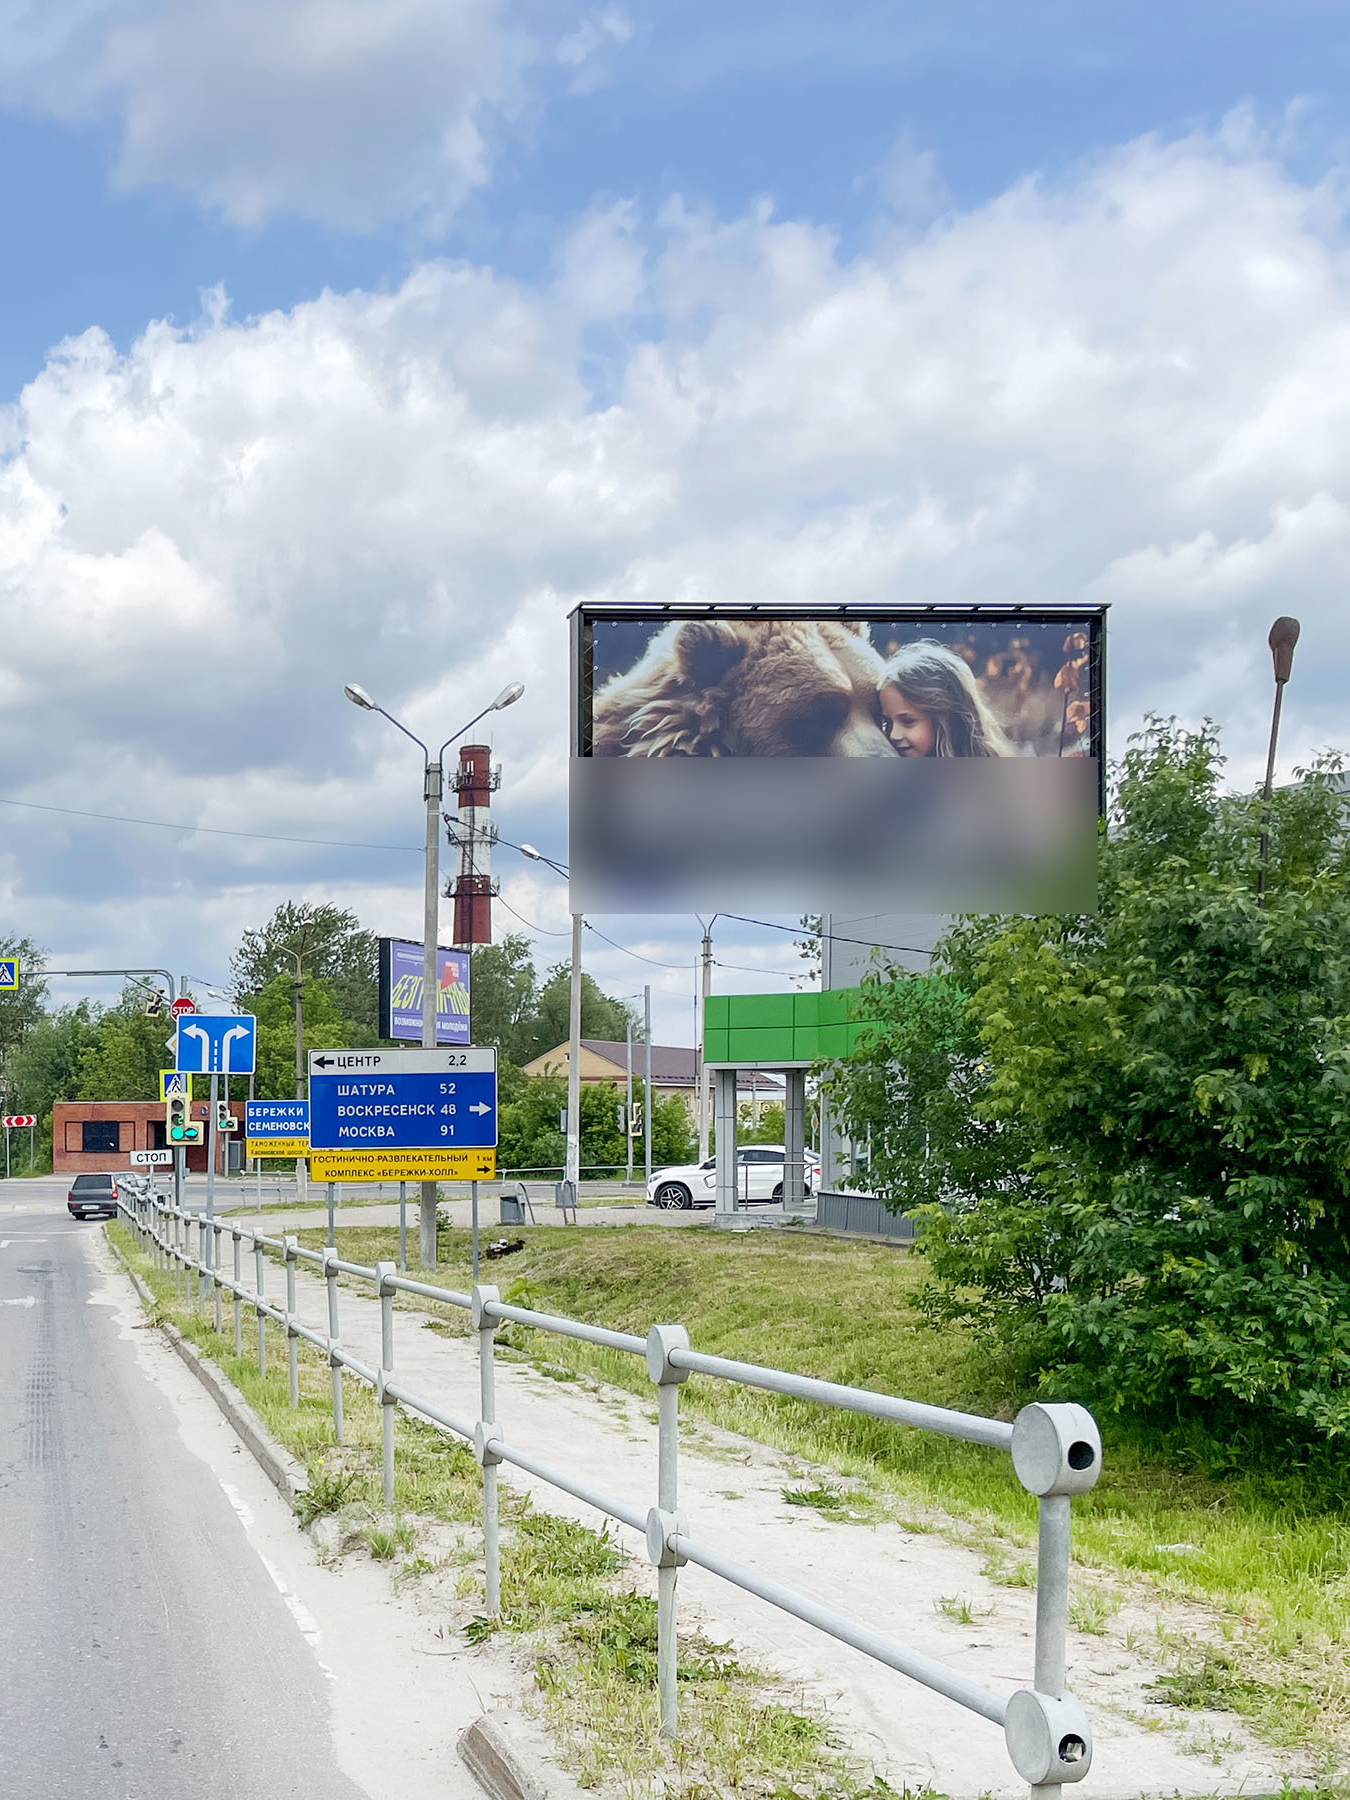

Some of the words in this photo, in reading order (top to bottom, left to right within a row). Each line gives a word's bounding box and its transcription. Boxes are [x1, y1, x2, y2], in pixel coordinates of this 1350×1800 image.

[172, 1006, 194, 1015] STOP
[337, 1056, 381, 1069] ЦЕНТР
[448, 1055, 467, 1067] 2,2
[337, 1084, 395, 1096] ШАТУРА
[439, 1083, 456, 1095] 52
[248, 1107, 304, 1117] БЕРЕЖКИ
[337, 1104, 435, 1117] ВОСКРЕСЕНСК
[440, 1103, 457, 1115] 48
[338, 1125, 395, 1138] МОСКВА
[440, 1124, 454, 1136] 91
[250, 1140, 295, 1148] ТАМОЖЕННЫЙ
[136, 1152, 167, 1163] СТОП
[313, 1153, 468, 1164] ГОСТИНИЧНО-РАЗВЛЕКАТЕЛЬНЫЙ
[324, 1169, 375, 1178] КОМПЛЕКС
[377, 1168, 458, 1178] «БЕРЕЖКИ-ХОЛЛ»
